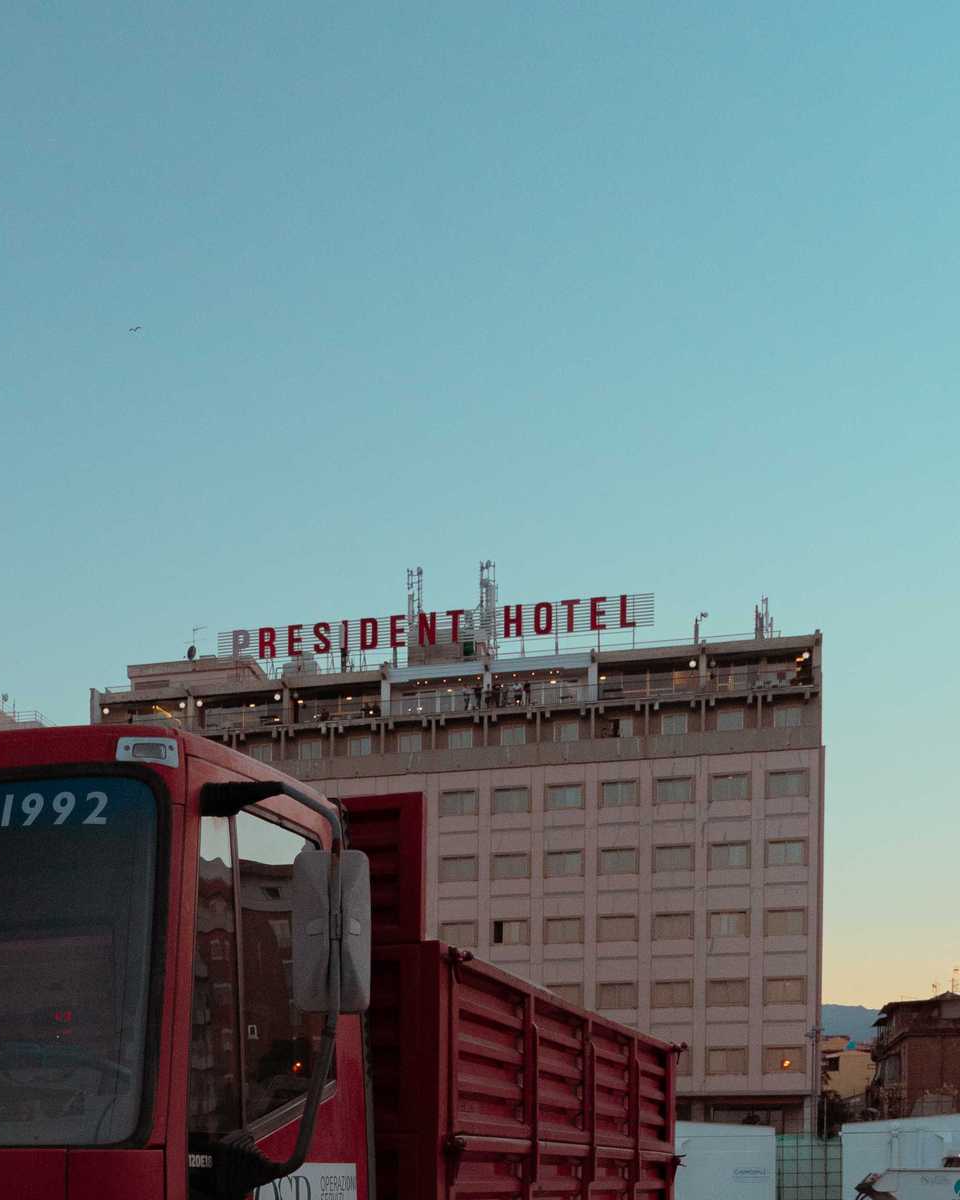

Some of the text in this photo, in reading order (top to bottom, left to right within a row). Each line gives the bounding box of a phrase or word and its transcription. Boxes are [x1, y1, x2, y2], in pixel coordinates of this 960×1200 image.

[232, 594, 636, 659] PRESIDENT HOTEL
[0, 791, 109, 827] 1992
